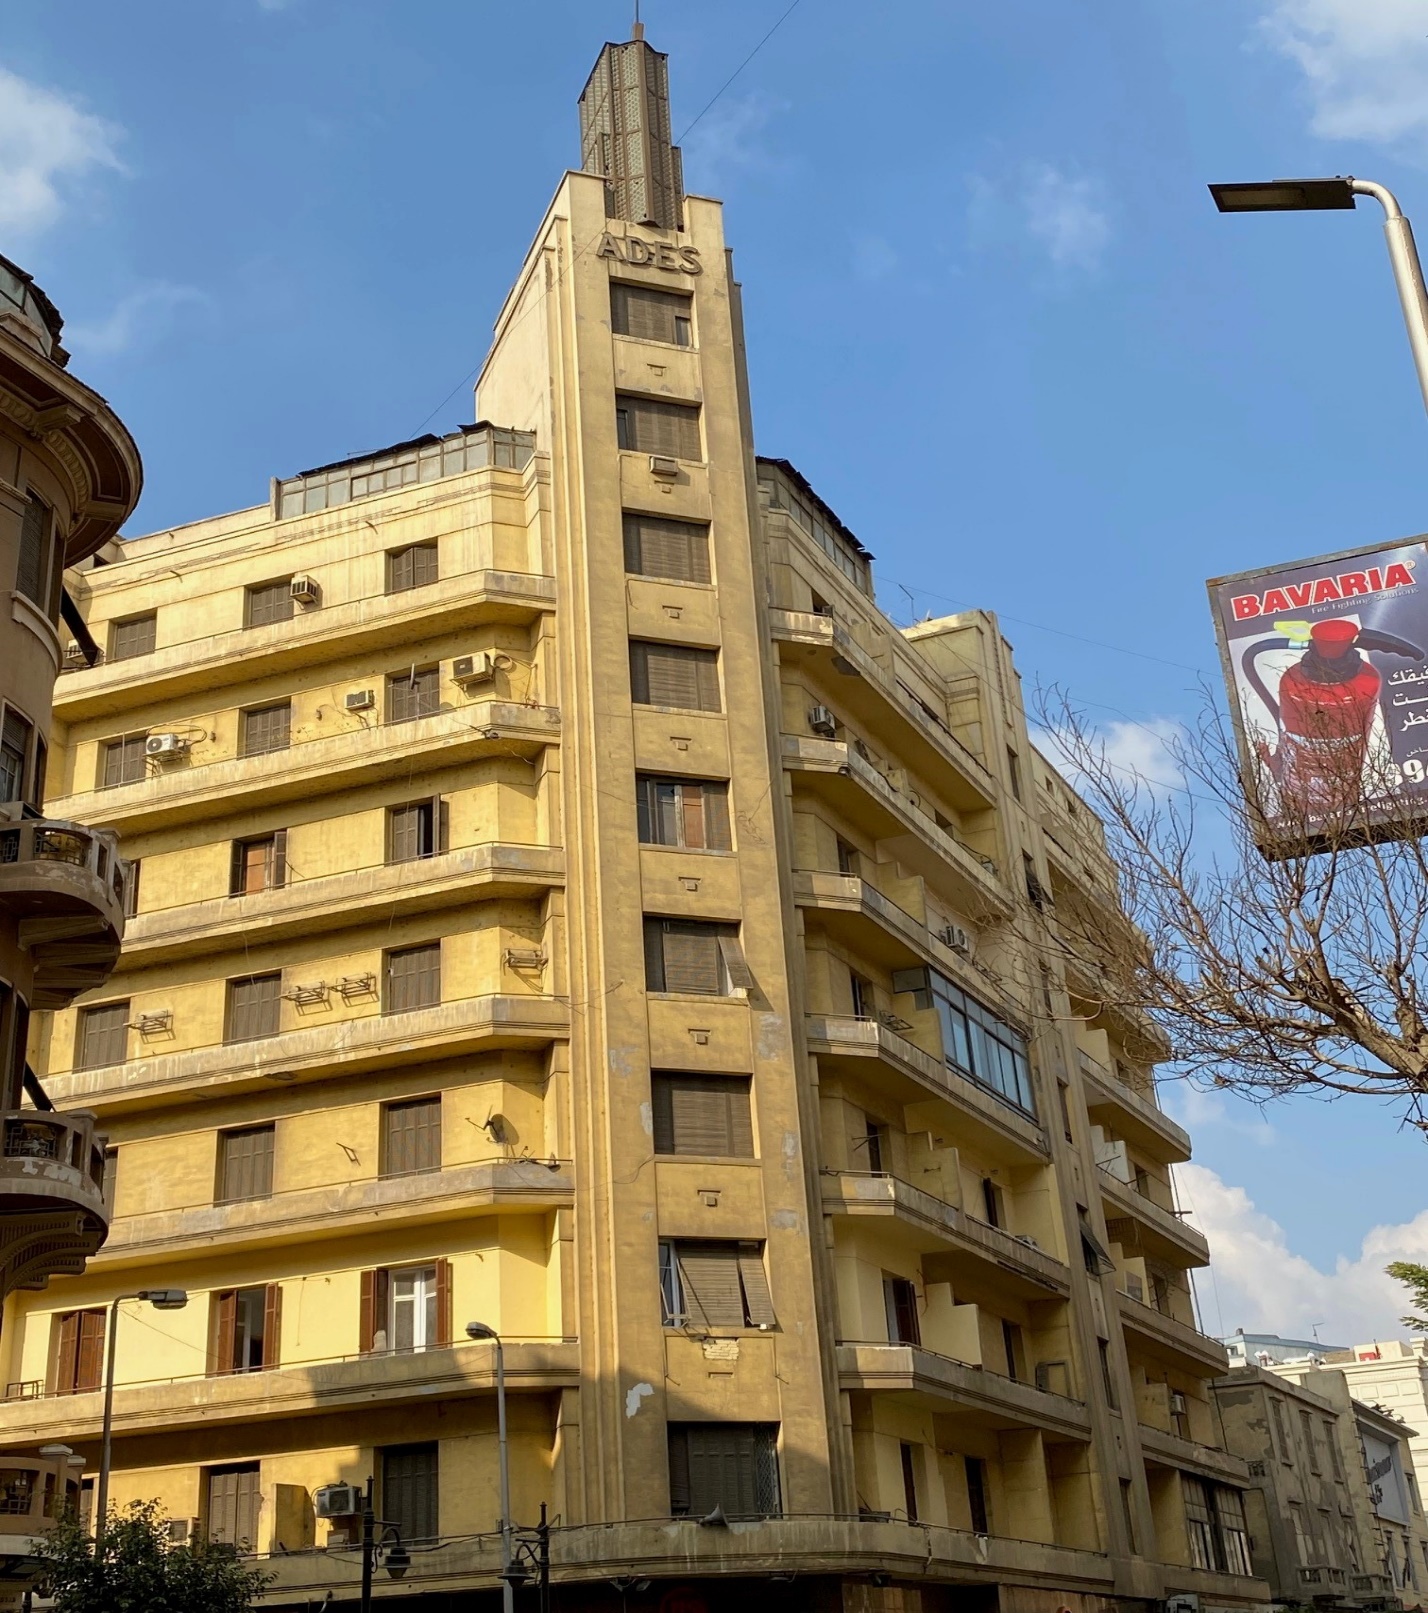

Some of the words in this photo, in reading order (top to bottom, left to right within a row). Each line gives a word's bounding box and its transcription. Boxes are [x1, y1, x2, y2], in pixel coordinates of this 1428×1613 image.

[596, 231, 702, 275] ADES
[1231, 561, 1416, 620] BAVARIA
[1311, 605, 1330, 614] Fire
[1374, 587, 1419, 601] Solutions
